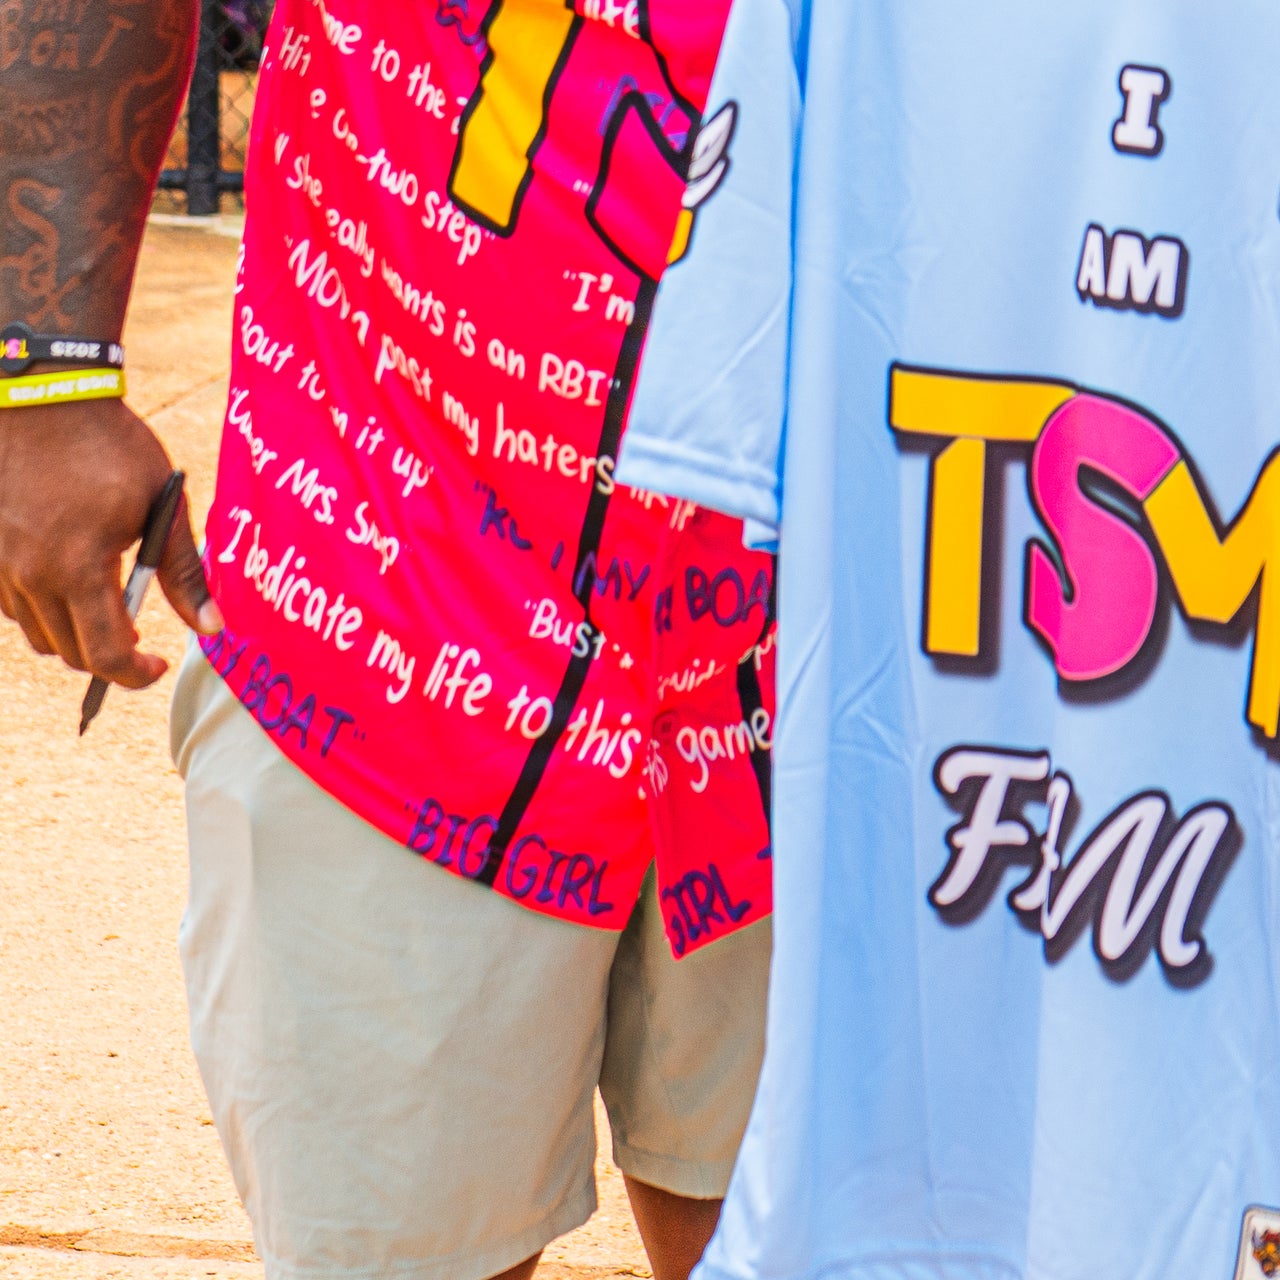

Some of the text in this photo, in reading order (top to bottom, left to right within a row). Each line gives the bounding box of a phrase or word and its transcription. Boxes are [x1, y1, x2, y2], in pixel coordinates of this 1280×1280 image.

[371, 39, 447, 120] to the
[1111, 62, 1171, 158] I
[1075, 222, 1189, 320] AM
[453, 307, 477, 358] is
[487, 338, 526, 380] an
[355, 415, 386, 456] it
[373, 331, 433, 403] past
[443, 389, 479, 457] my
[493, 402, 616, 496] haters
[684, 566, 772, 628] BOA
[242, 522, 364, 652] dedicate
[367, 629, 416, 705] my
[423, 641, 494, 716] life
[506, 684, 555, 740] to
[564, 699, 642, 779] this
[676, 707, 773, 794] game
[504, 832, 615, 917] GIRL
